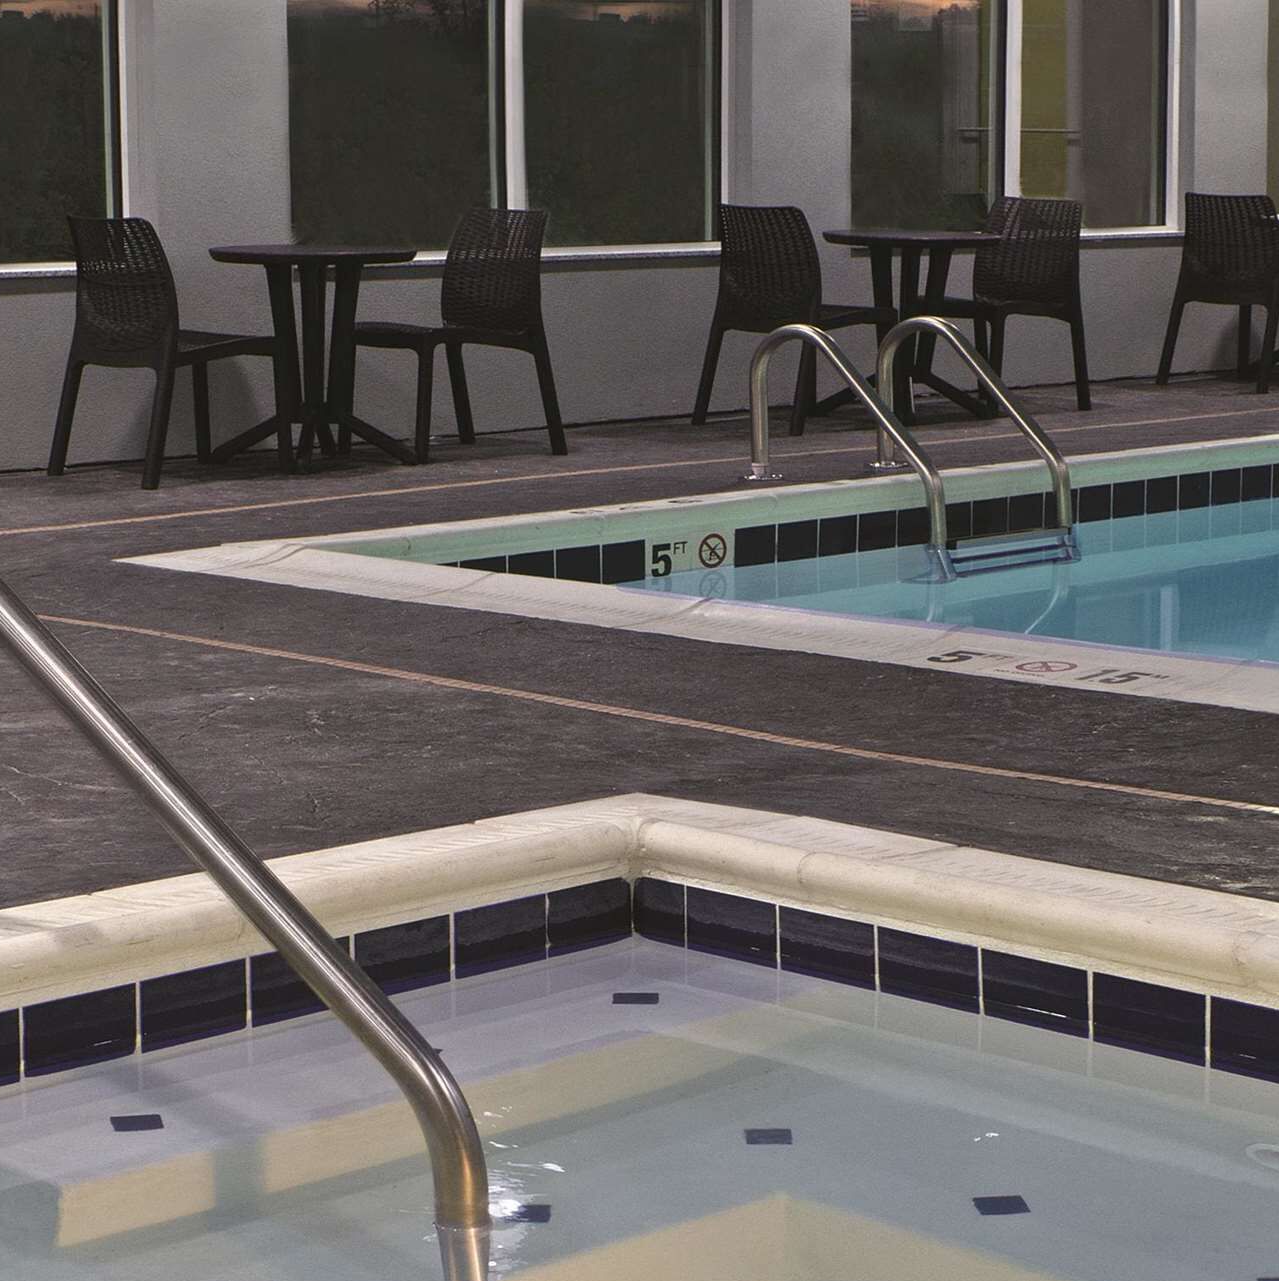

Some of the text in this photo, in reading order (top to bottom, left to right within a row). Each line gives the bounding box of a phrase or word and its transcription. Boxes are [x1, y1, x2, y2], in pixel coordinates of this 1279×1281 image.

[652, 542, 688, 577] 5 FT
[926, 650, 988, 663] 5
